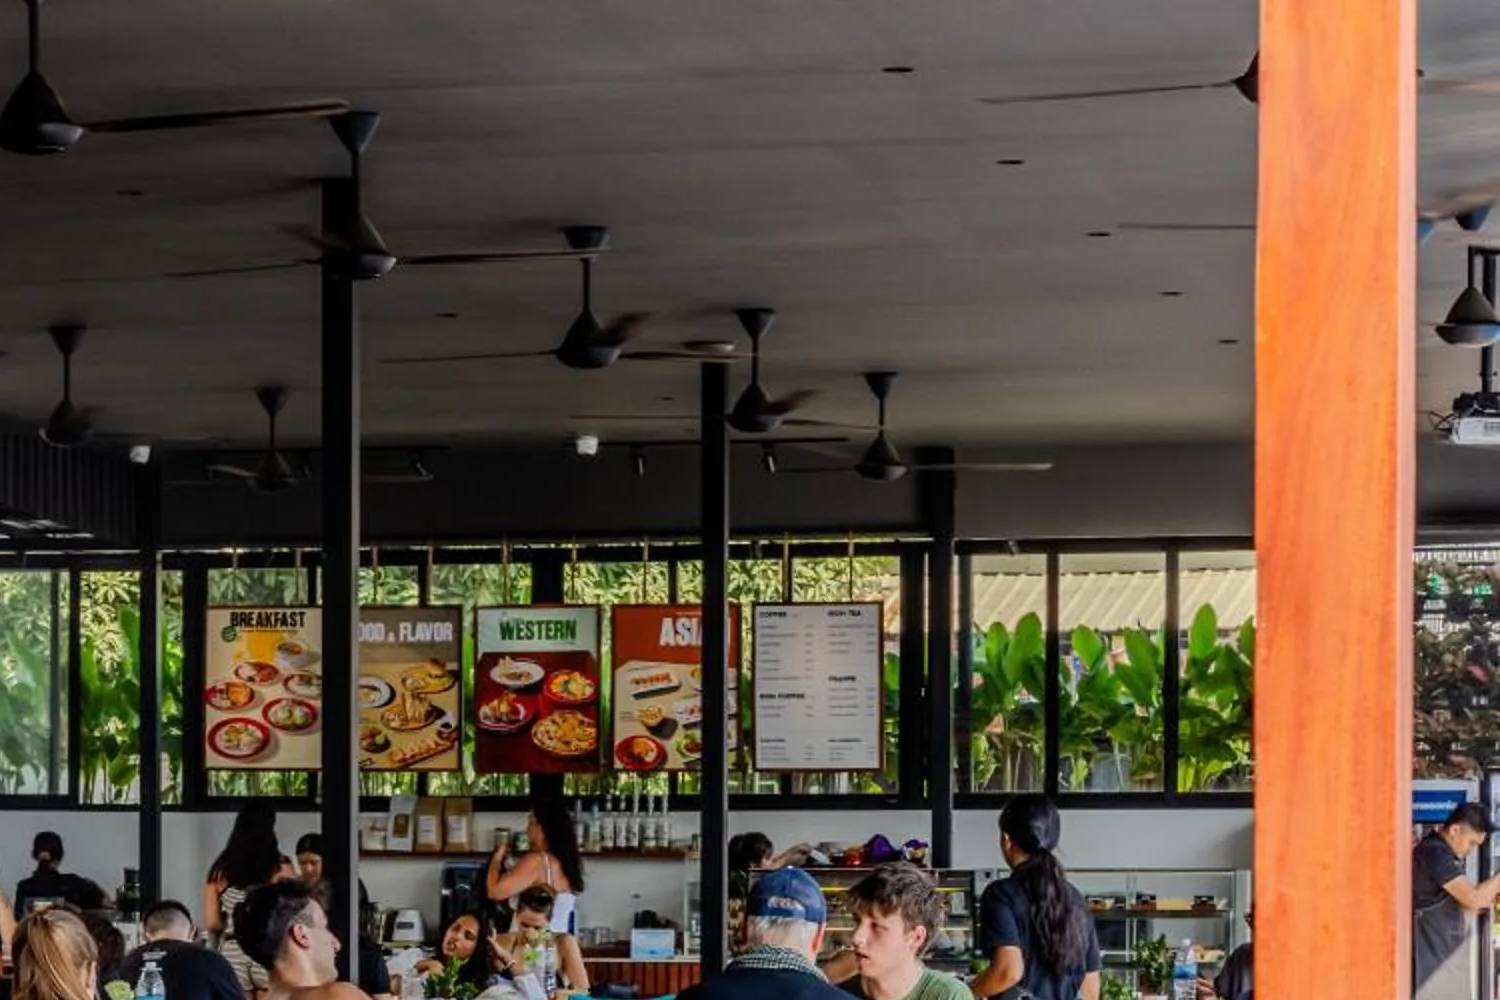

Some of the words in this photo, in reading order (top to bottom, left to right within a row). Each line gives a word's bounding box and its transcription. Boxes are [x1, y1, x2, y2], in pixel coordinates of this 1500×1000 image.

[230, 611, 306, 628] BREAKFAST
[499, 618, 577, 641] WESTERN
[399, 621, 453, 642] FLAVOR
